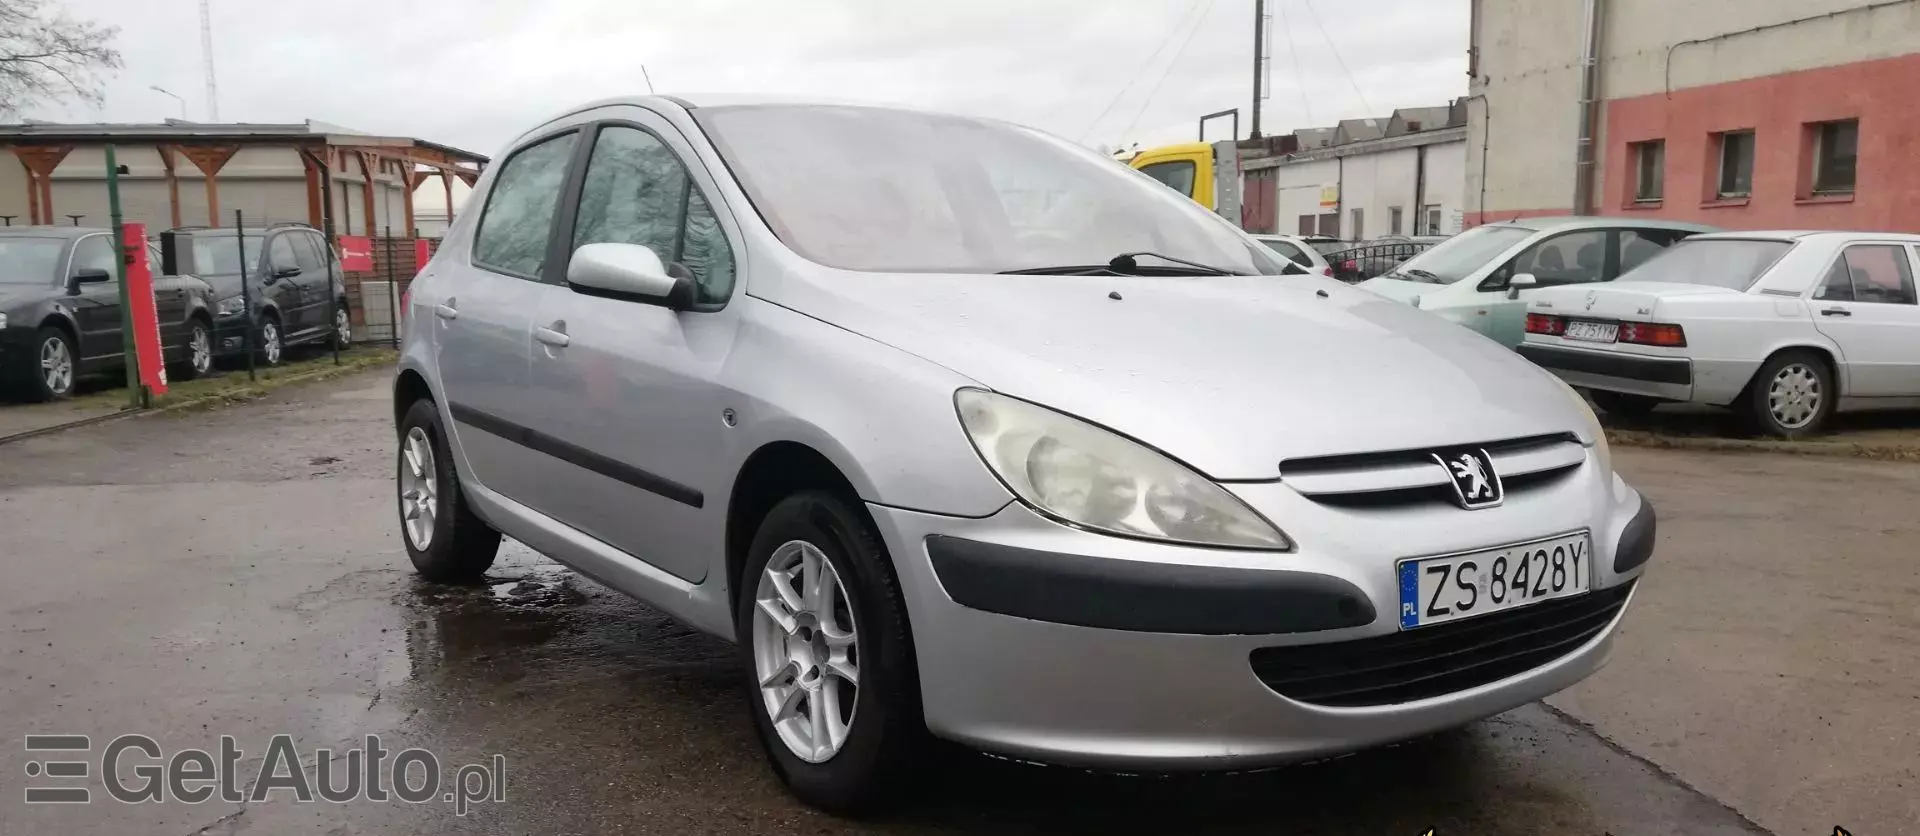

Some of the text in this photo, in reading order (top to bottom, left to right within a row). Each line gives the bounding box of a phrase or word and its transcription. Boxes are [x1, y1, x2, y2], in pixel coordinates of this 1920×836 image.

[1569, 322, 1583, 336] PZ
[1426, 541, 1583, 617] ZS 8428Y
[1403, 602, 1416, 617] PL
